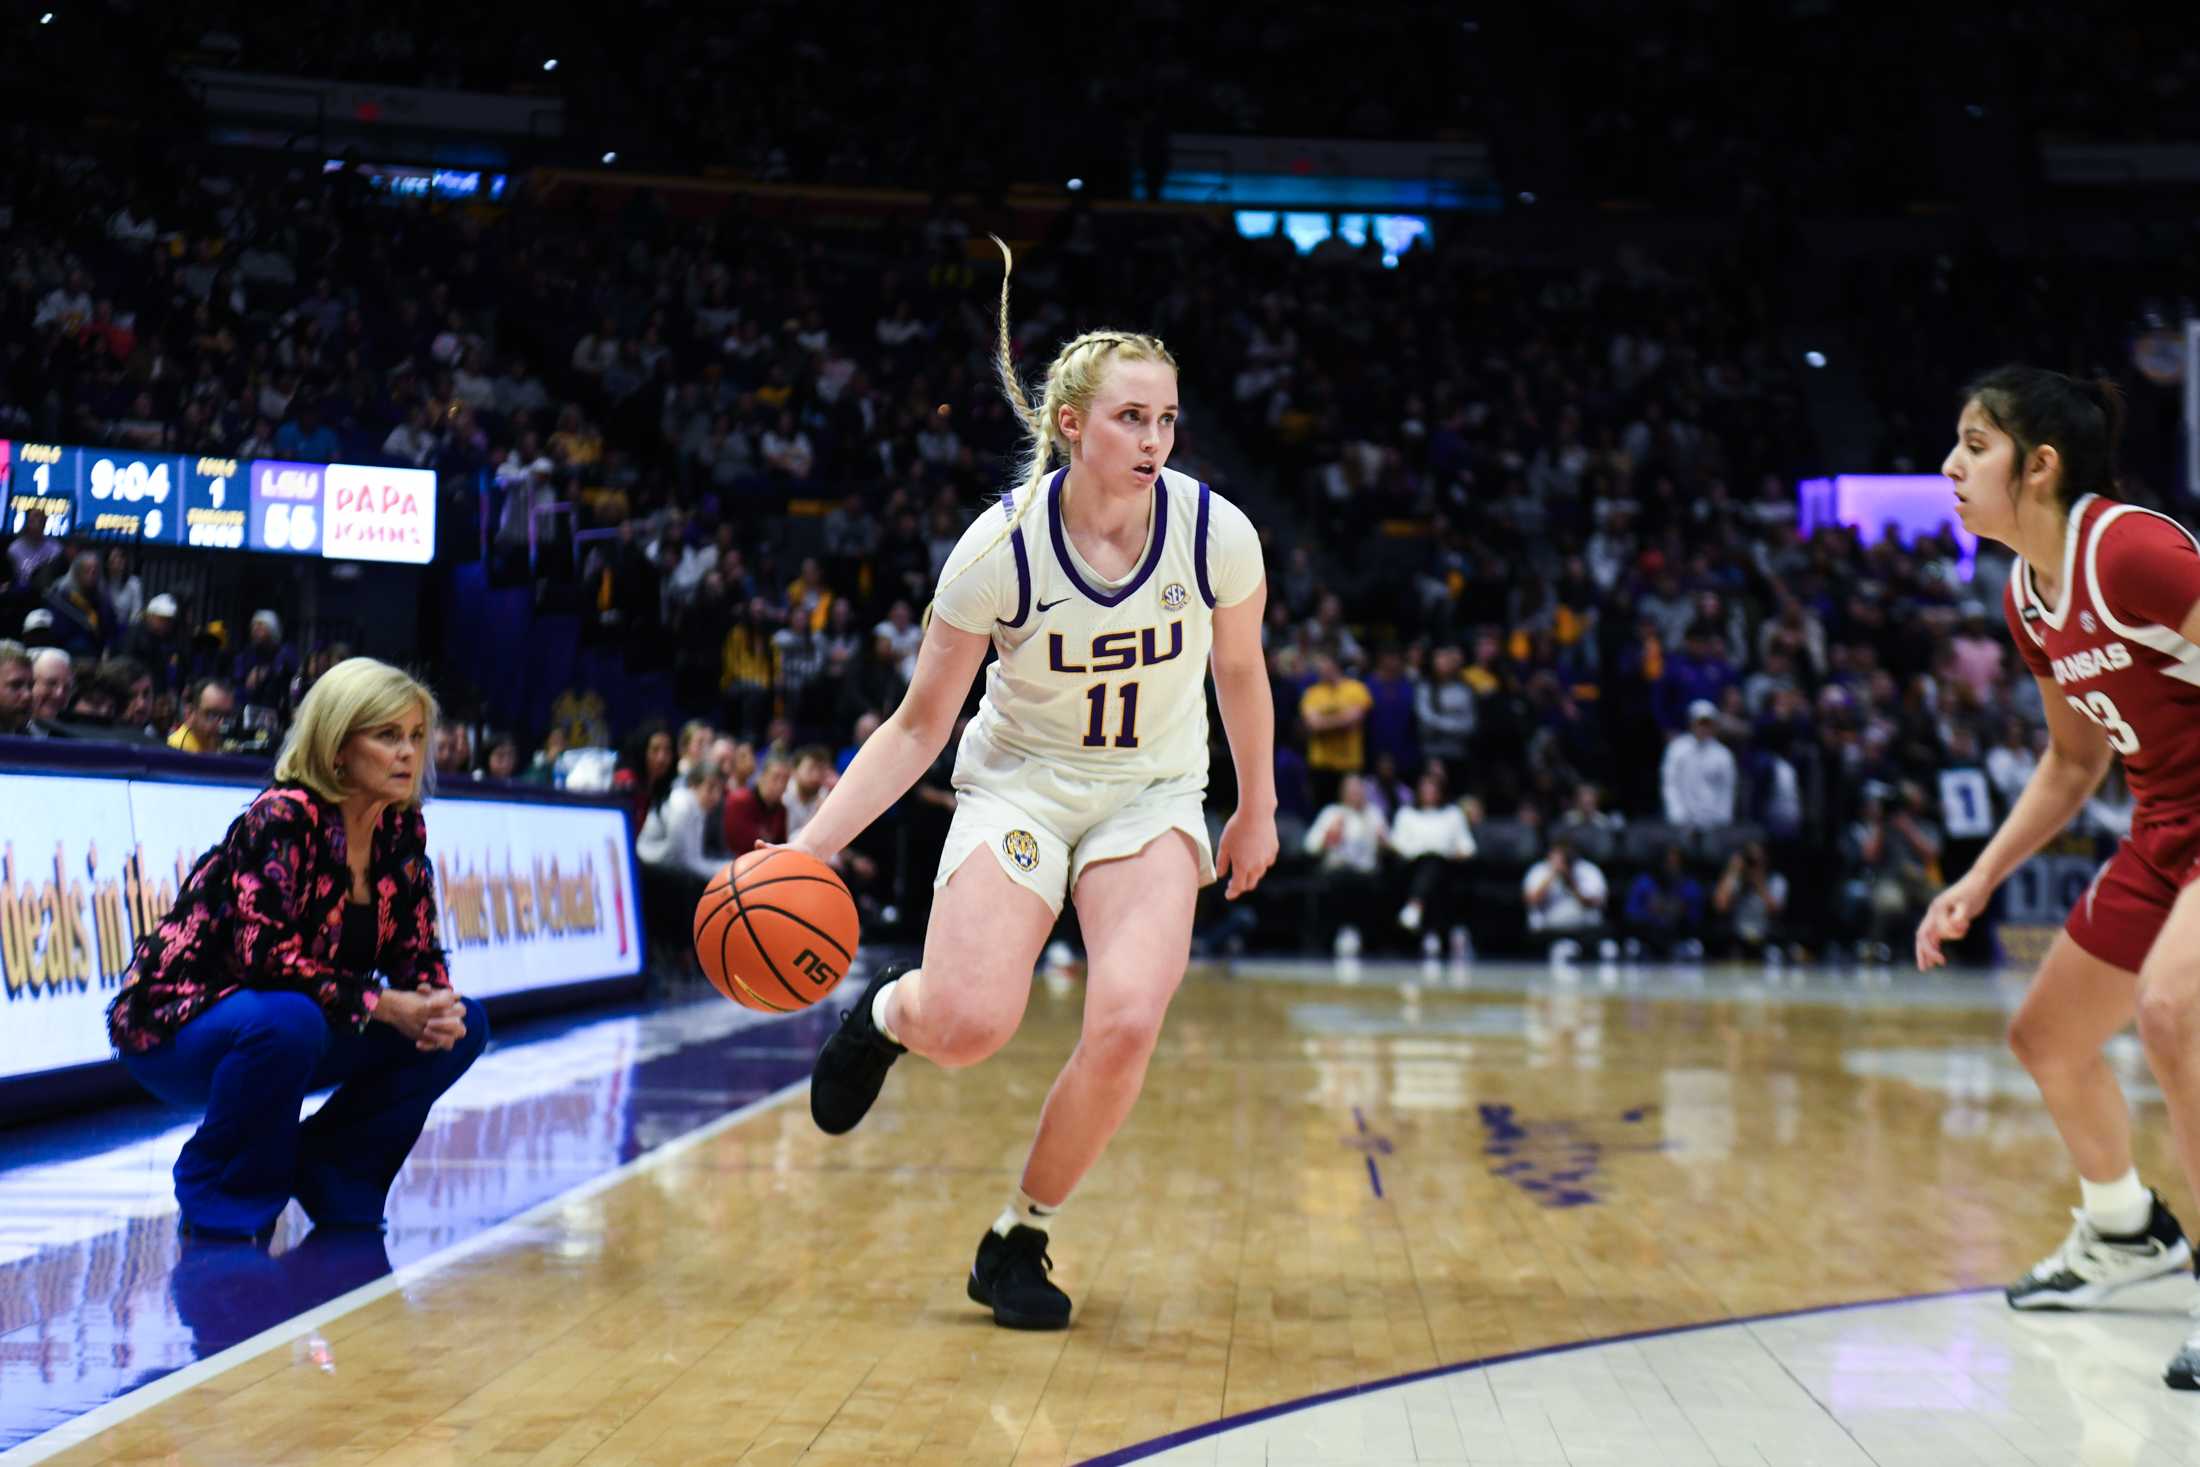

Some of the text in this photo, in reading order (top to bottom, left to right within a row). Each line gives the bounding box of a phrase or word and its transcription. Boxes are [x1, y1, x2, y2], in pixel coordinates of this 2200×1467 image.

[33, 463, 50, 496] 1
[90, 458, 170, 504] 9:04
[209, 476, 226, 509] 1
[336, 484, 418, 515] PAPA
[1049, 620, 1184, 674] LSU
[1081, 680, 1140, 749] 11
[793, 948, 841, 992] LSU
